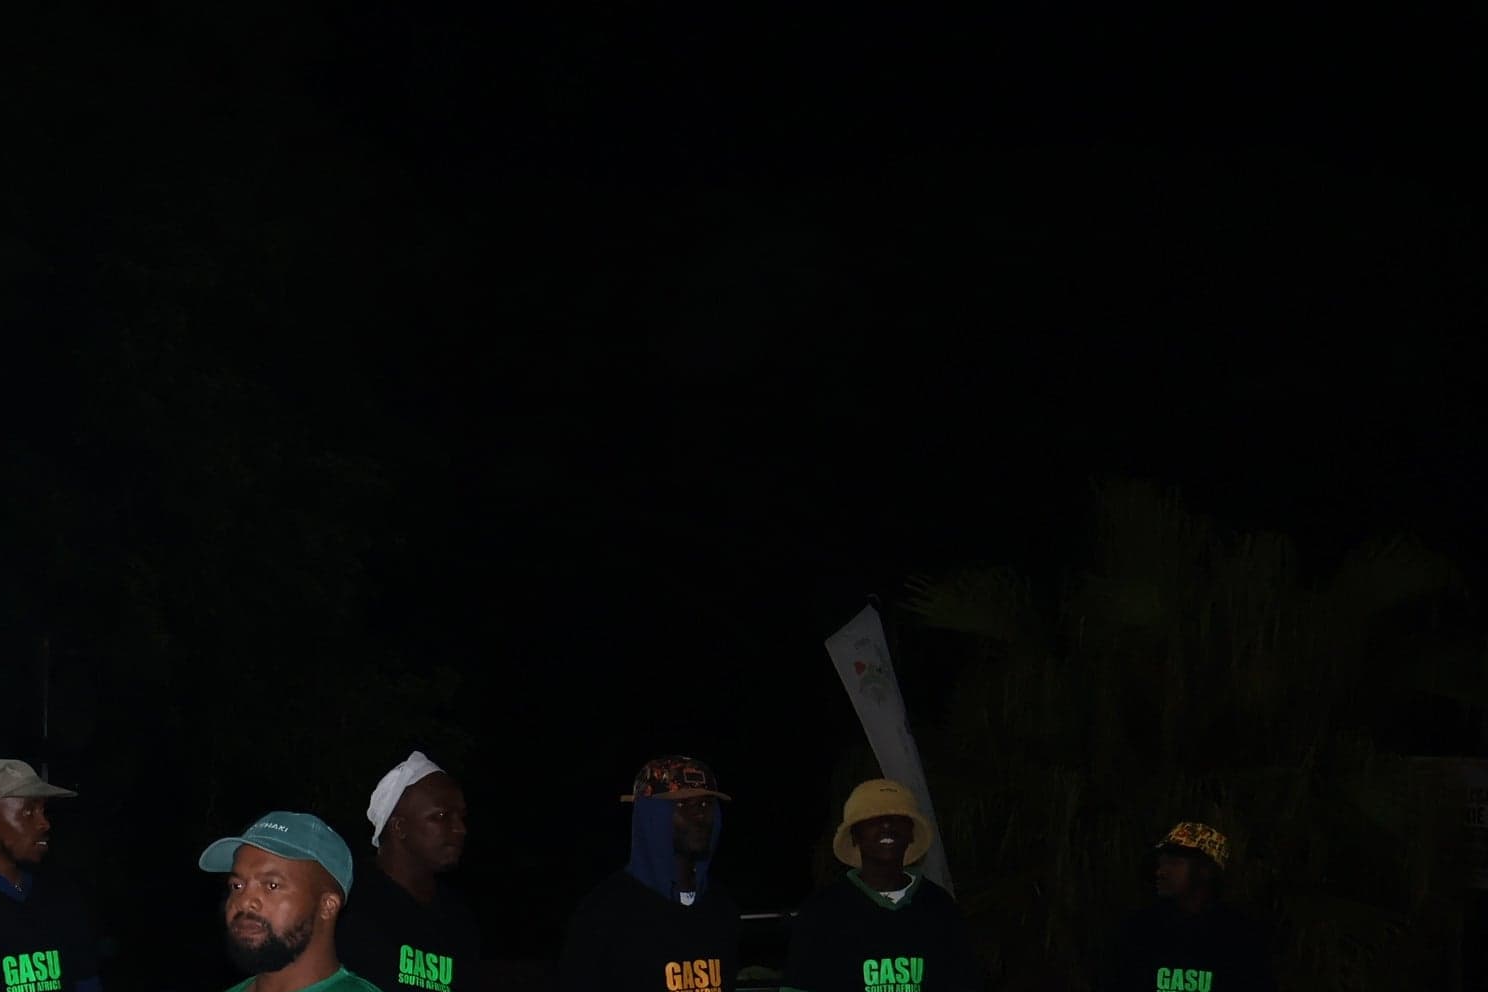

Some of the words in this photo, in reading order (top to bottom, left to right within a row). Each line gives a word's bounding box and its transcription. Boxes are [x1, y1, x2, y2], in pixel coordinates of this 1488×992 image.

[2, 950, 61, 986] GASU
[400, 944, 453, 985] GASU
[665, 959, 722, 991] GASU
[863, 957, 924, 986] GASU
[1157, 967, 1213, 992] GASU
[398, 973, 424, 988] SOUTH
